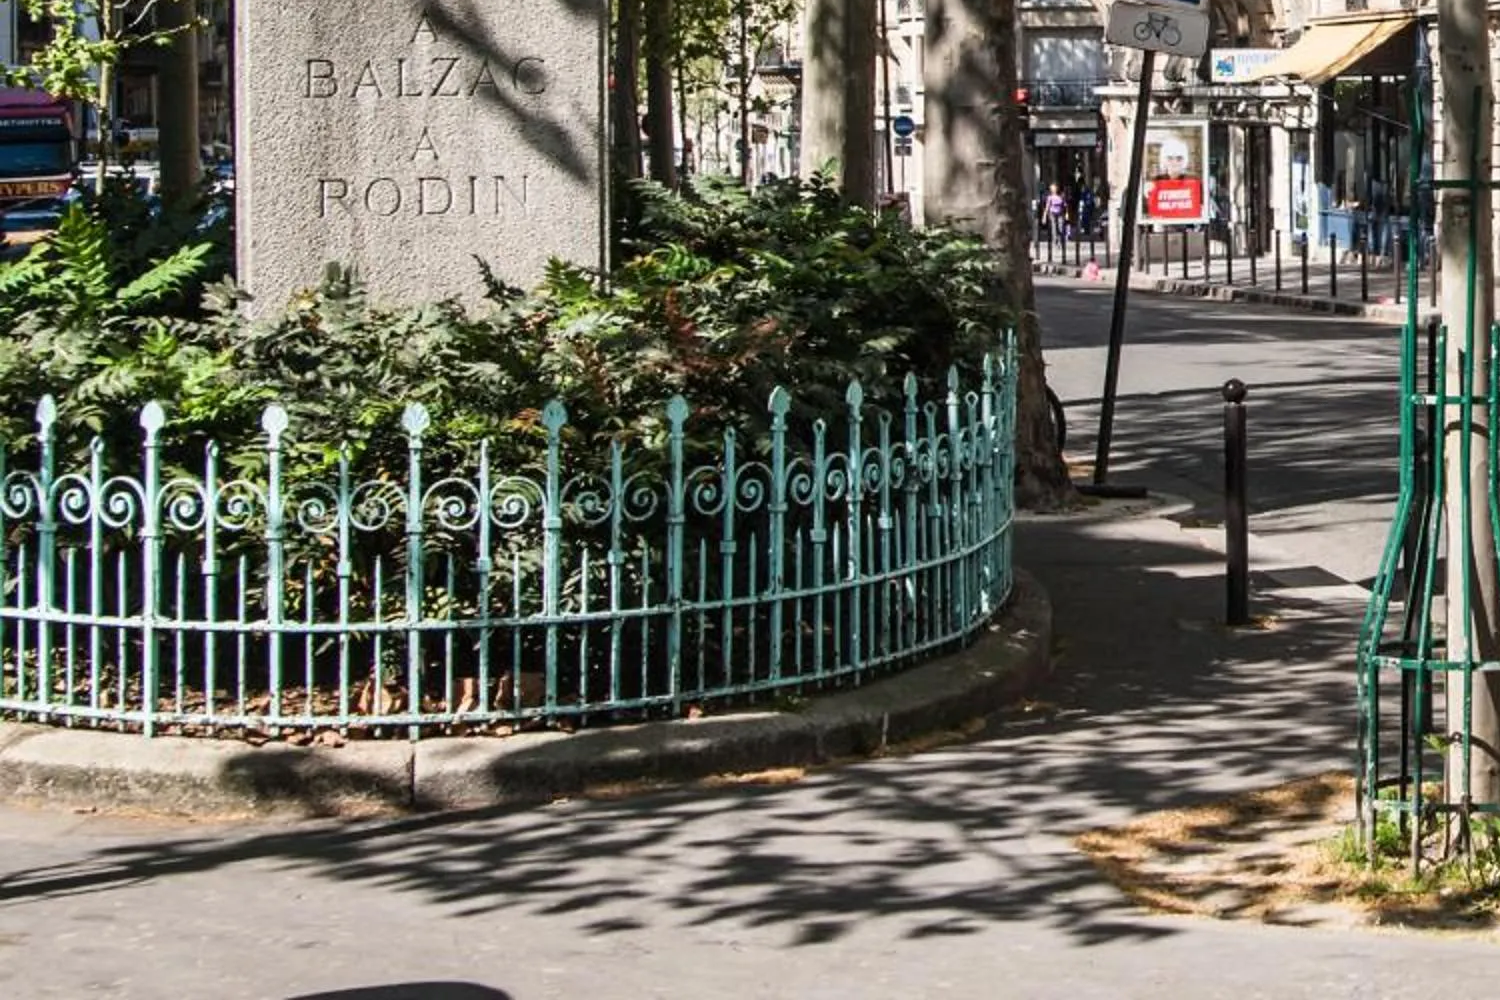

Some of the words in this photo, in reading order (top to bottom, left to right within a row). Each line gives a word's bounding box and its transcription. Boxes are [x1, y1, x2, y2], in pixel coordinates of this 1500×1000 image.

[410, 7, 439, 44] A
[304, 57, 550, 98] BALZAC
[410, 126, 440, 162] A
[318, 175, 530, 218] RODIN
